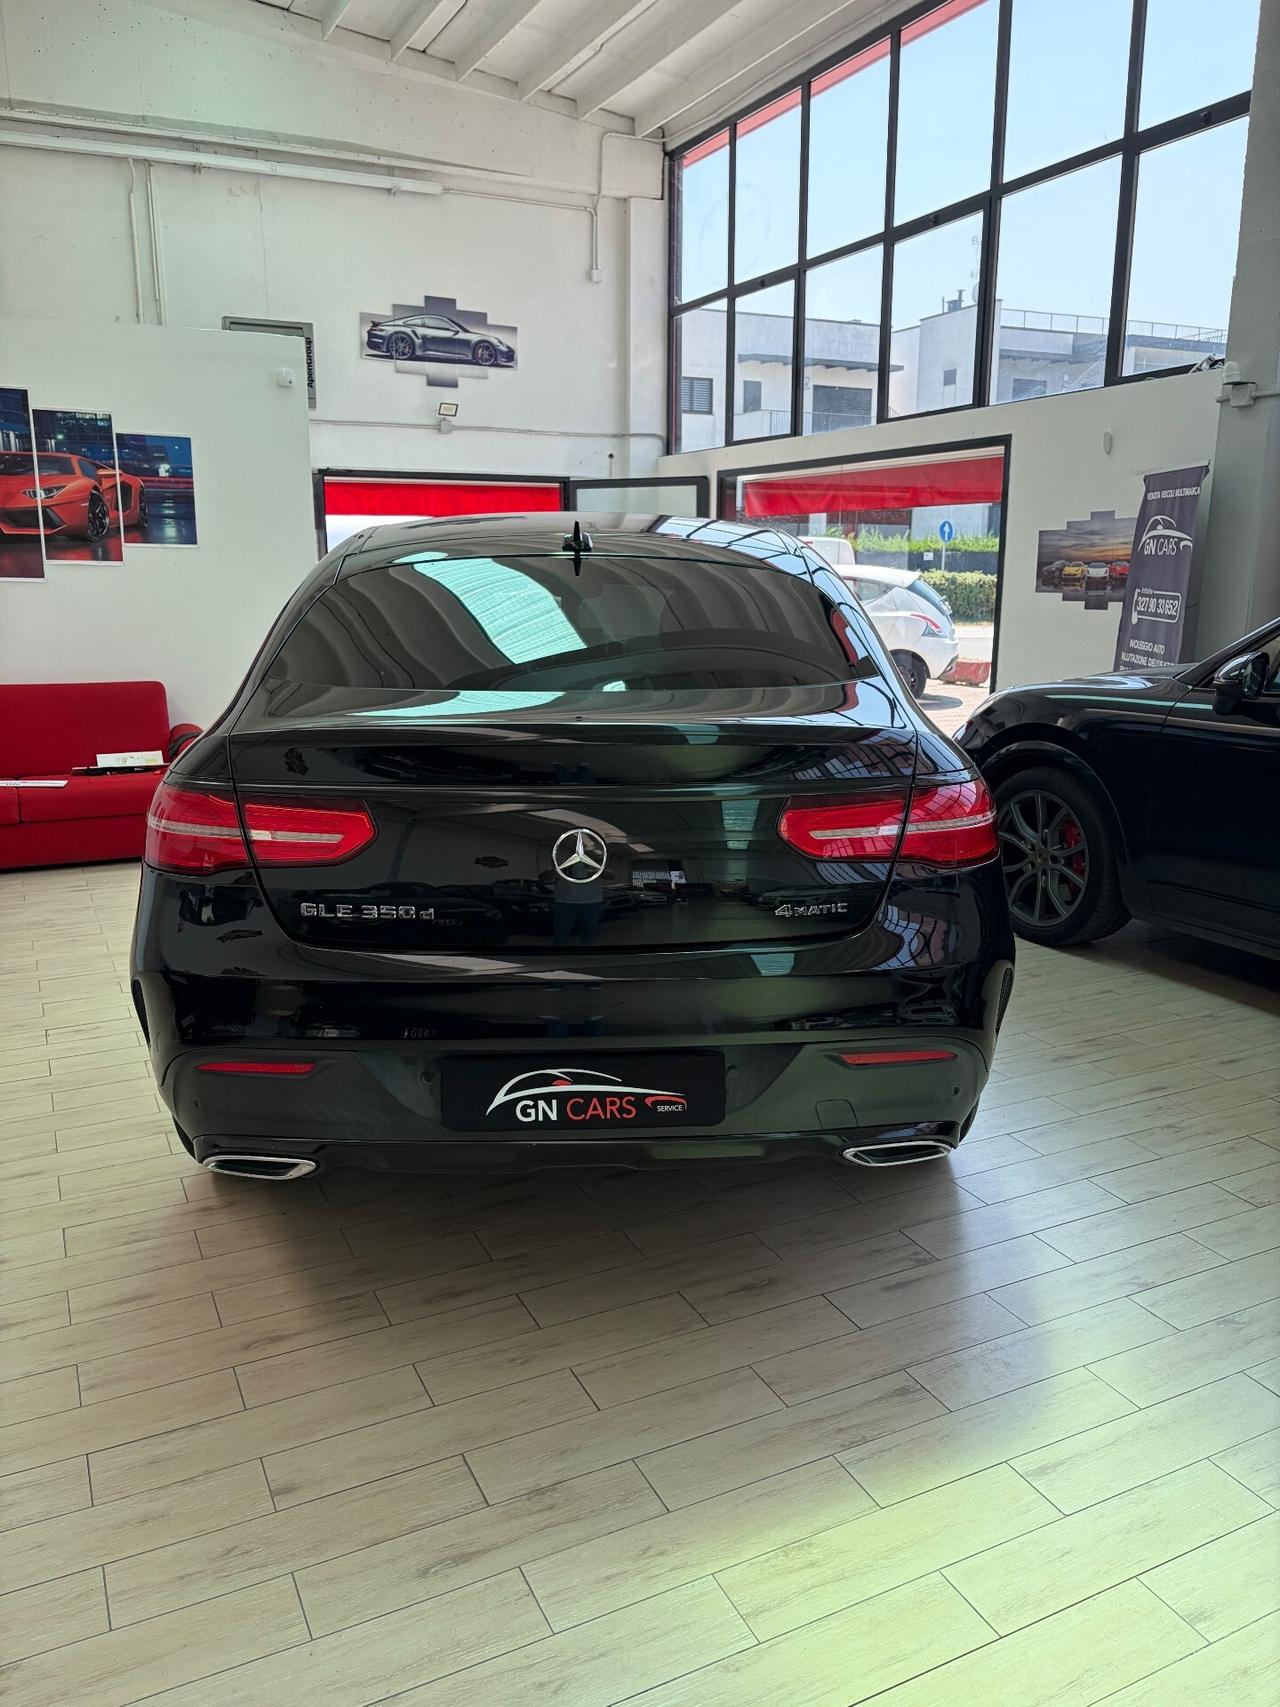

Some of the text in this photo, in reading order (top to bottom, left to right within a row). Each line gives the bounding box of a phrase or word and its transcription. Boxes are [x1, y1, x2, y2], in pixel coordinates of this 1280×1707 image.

[1144, 538, 1178, 556] GN CARS
[1129, 639, 1165, 655] NOLEGGIO AUTO
[300, 902, 353, 918] GLE
[775, 902, 848, 918] 4MATIC
[516, 1096, 683, 1122] GN CARS SERVICE
